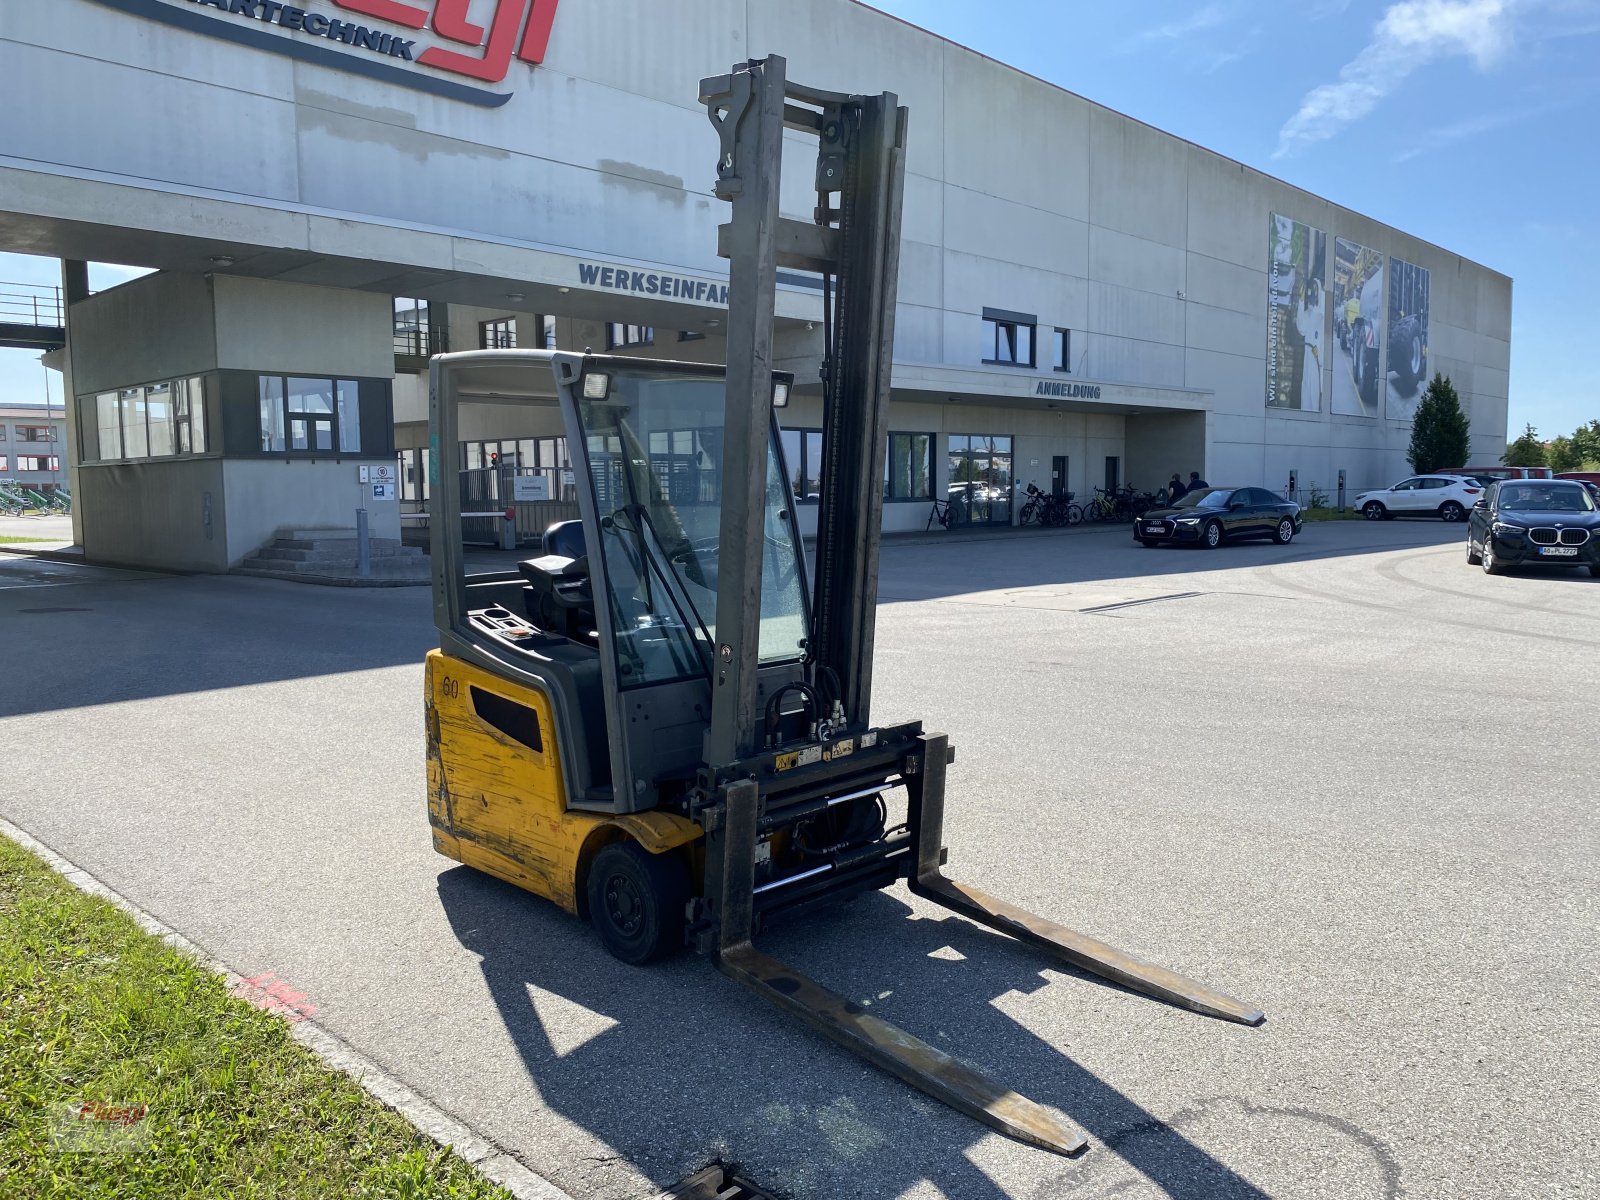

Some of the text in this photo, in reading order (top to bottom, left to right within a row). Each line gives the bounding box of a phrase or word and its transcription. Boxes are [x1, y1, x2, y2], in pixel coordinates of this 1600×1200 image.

[1036, 381, 1101, 399] ANMELDUNG
[1268, 380, 1276, 402] Wir
[443, 676, 459, 699] 60
